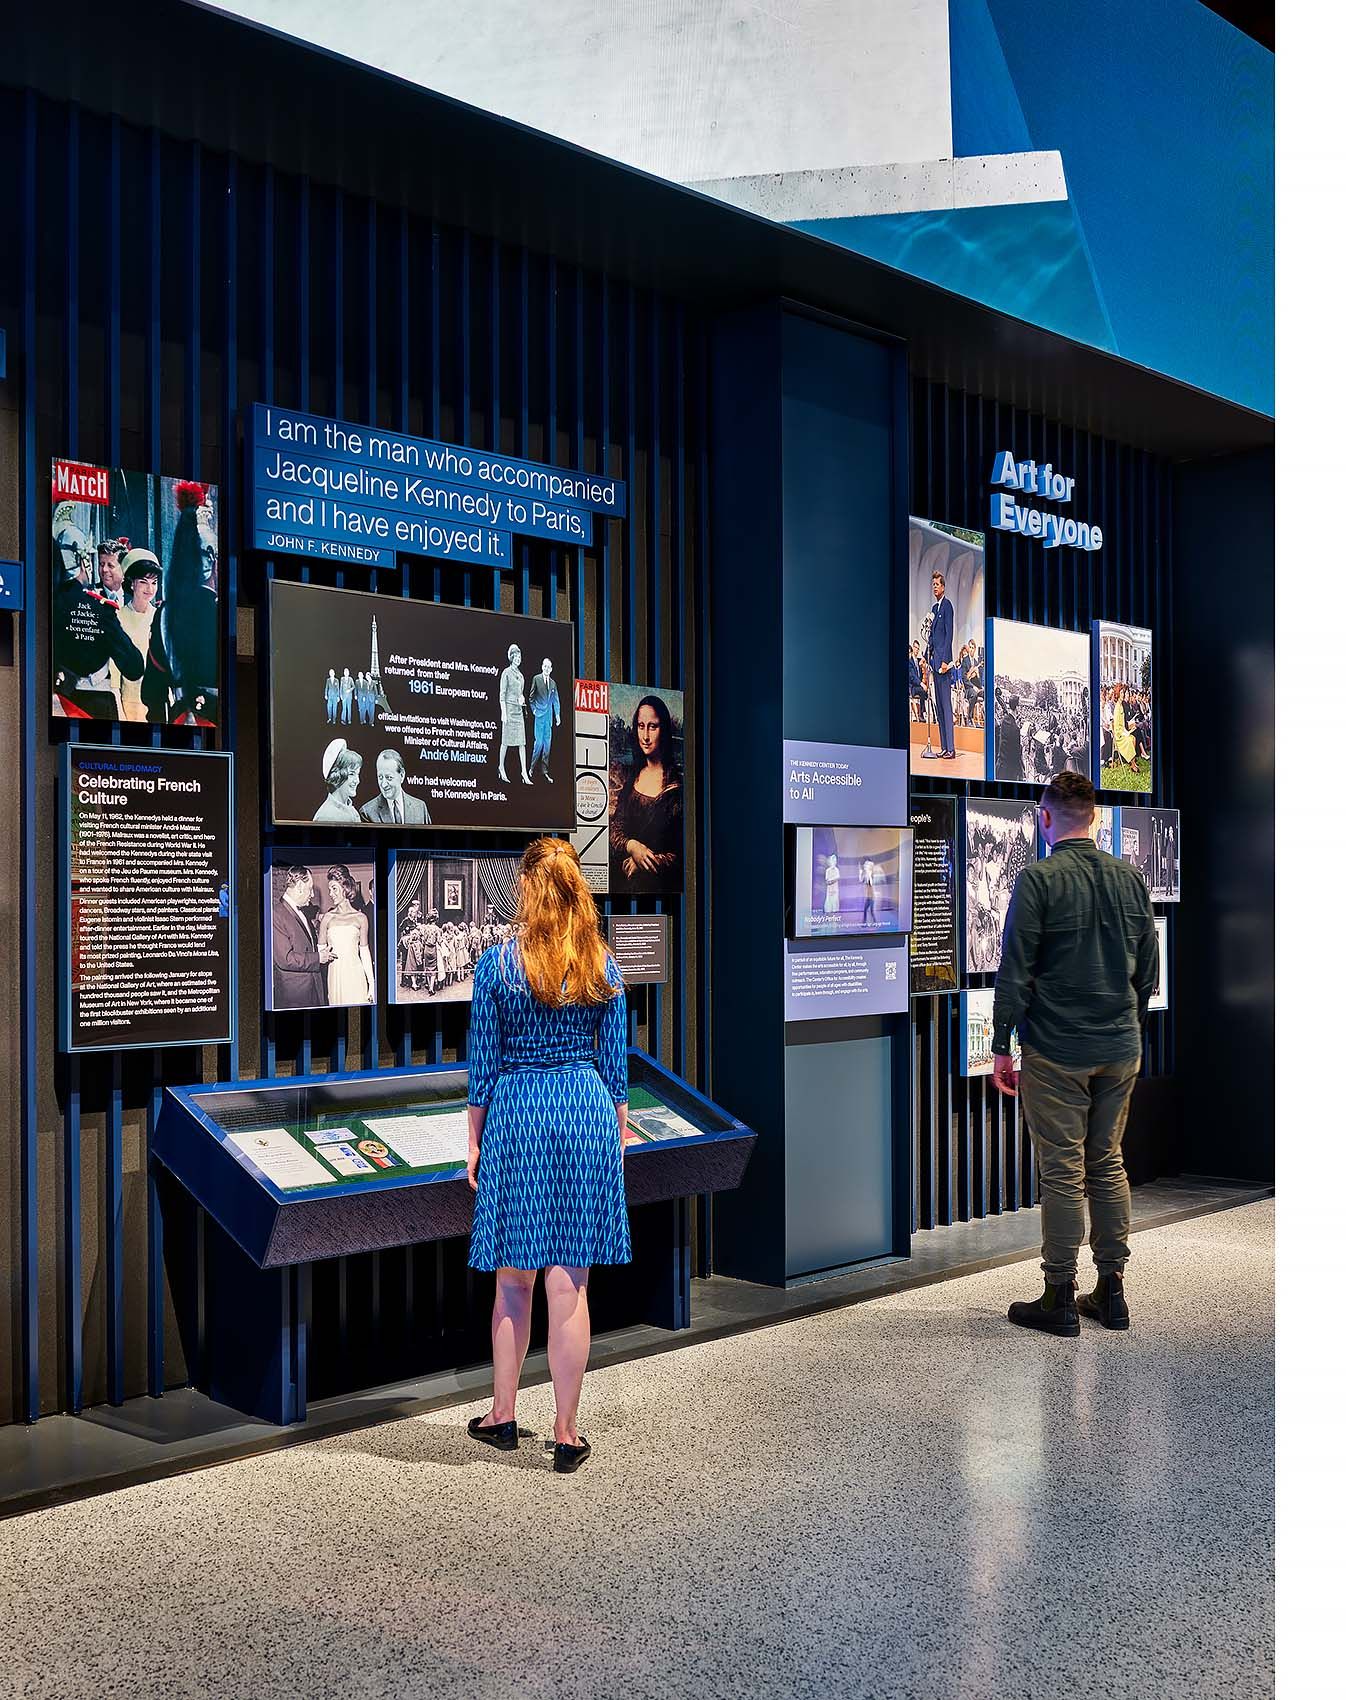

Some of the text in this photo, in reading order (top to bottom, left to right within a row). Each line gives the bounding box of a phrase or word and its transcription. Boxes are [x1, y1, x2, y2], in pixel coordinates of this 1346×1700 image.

[266, 409, 615, 505] I am the man who accompanied
[57, 465, 107, 499] MATCH
[994, 451, 1075, 502] Art for
[266, 452, 585, 539] Jacqueline Kennedy to Paris,
[266, 498, 505, 557] and I have enjoyed it.
[992, 493, 1103, 551] Everyone
[268, 534, 380, 562] JOHN F. KENNEDY
[384, 666, 451, 681] returned from their
[389, 654, 499, 676] After President and Mrs. Kennedy
[408, 679, 489, 701] 1961 European tour,
[378, 712, 497, 730] official invitations to visit Washington, D.C.
[384, 725, 493, 740] were offered to French novelist and
[404, 735, 489, 751] Minister of Cultural Affairs,
[419, 747, 487, 764] André Malraux
[79, 761, 162, 773] CULTURAL DIPLOMACY
[78, 773, 201, 793] Celebrating French
[406, 775, 477, 788] who had welcomed
[789, 770, 862, 787] Arts Accessible
[78, 790, 128, 806] Culture
[430, 788, 508, 802] the Kennedys in Paris.
[790, 787, 814, 800] to All
[88, 812, 101, 820] May
[134, 813, 161, 822] Kennedys
[161, 814, 173, 822] held
[910, 813, 932, 824] eople's
